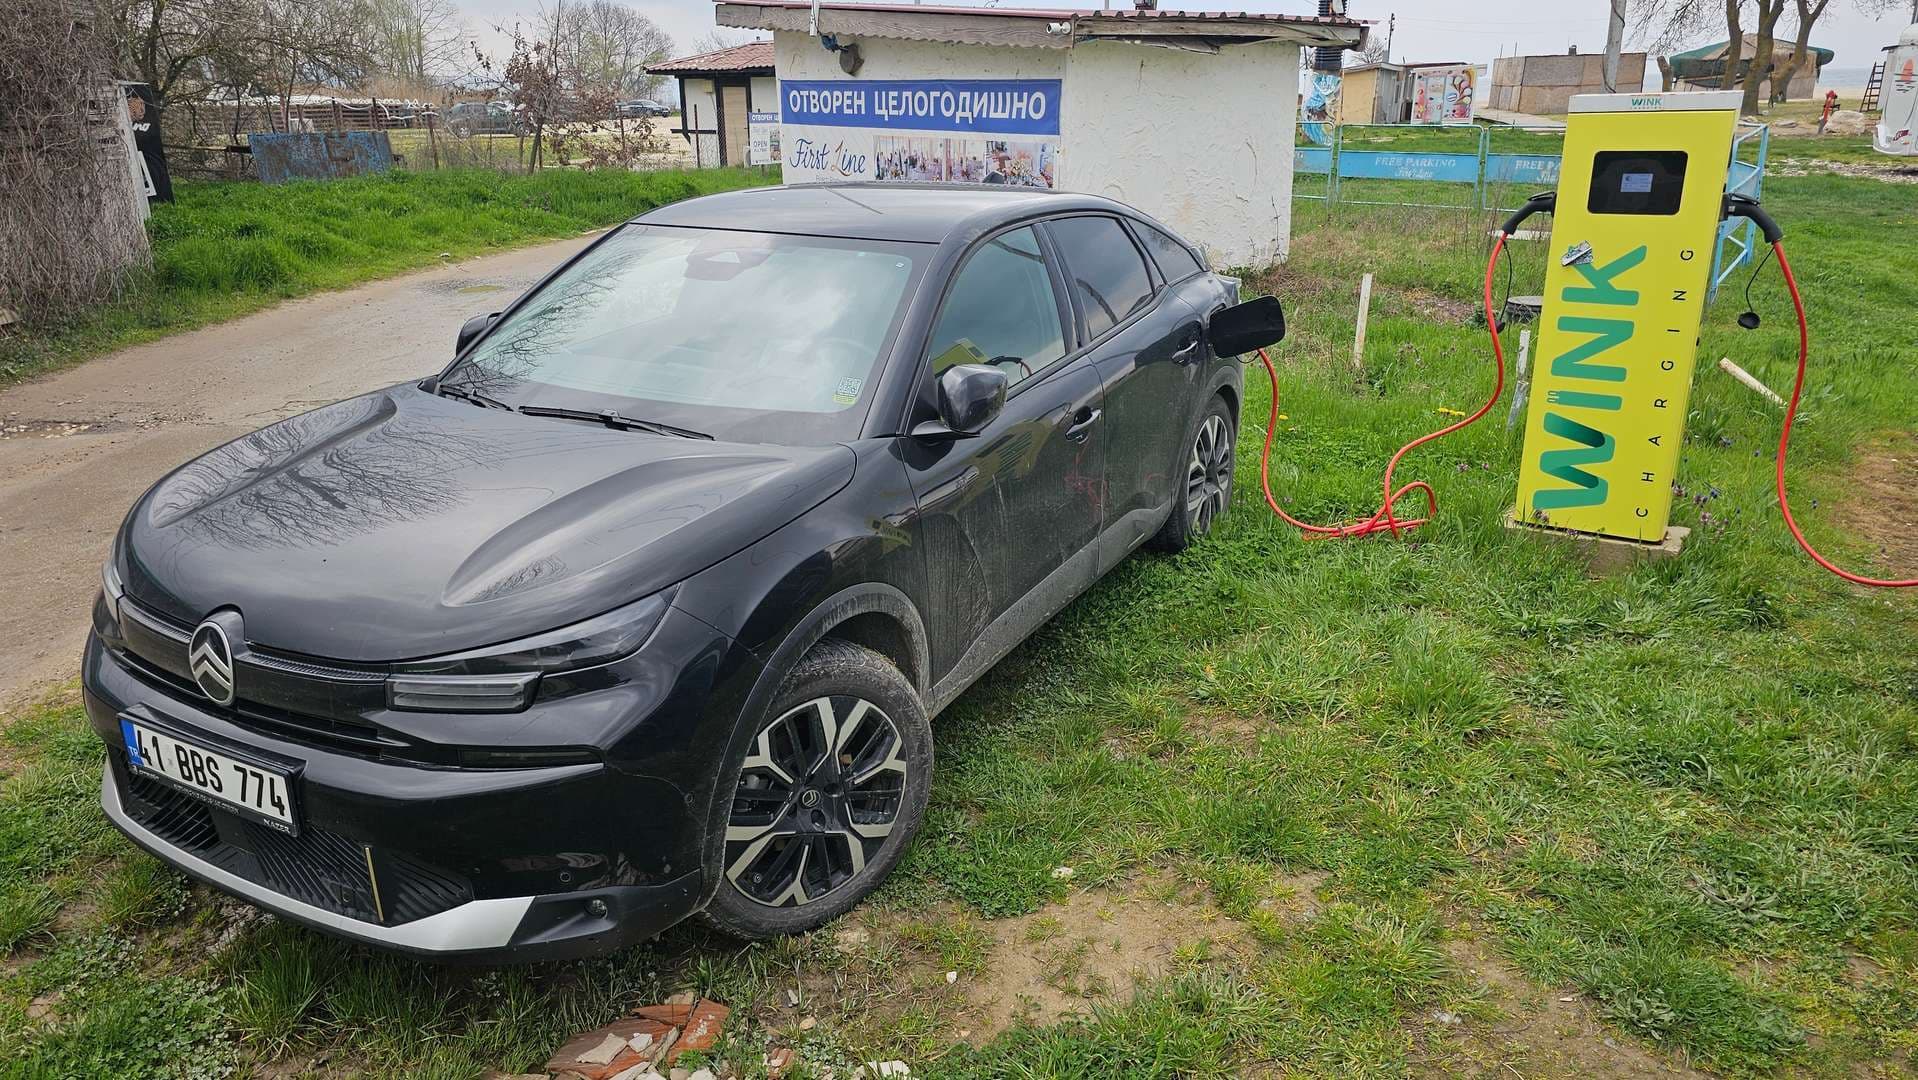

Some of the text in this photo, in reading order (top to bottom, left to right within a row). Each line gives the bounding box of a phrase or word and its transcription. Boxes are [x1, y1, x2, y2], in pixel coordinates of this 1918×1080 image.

[789, 90, 1046, 124] ОТВОРЕН ЦЕЛОГОДИШНО
[1631, 98, 1663, 106] WINK
[790, 138, 866, 177] First Line
[1375, 156, 1457, 168] FREE PARKING
[1515, 160, 1545, 170] FREE
[1532, 244, 1648, 510] WINK
[1635, 249, 1694, 518] CHARGING
[137, 730, 166, 772] 41
[174, 744, 223, 793] BBS
[233, 764, 285, 816] 774
